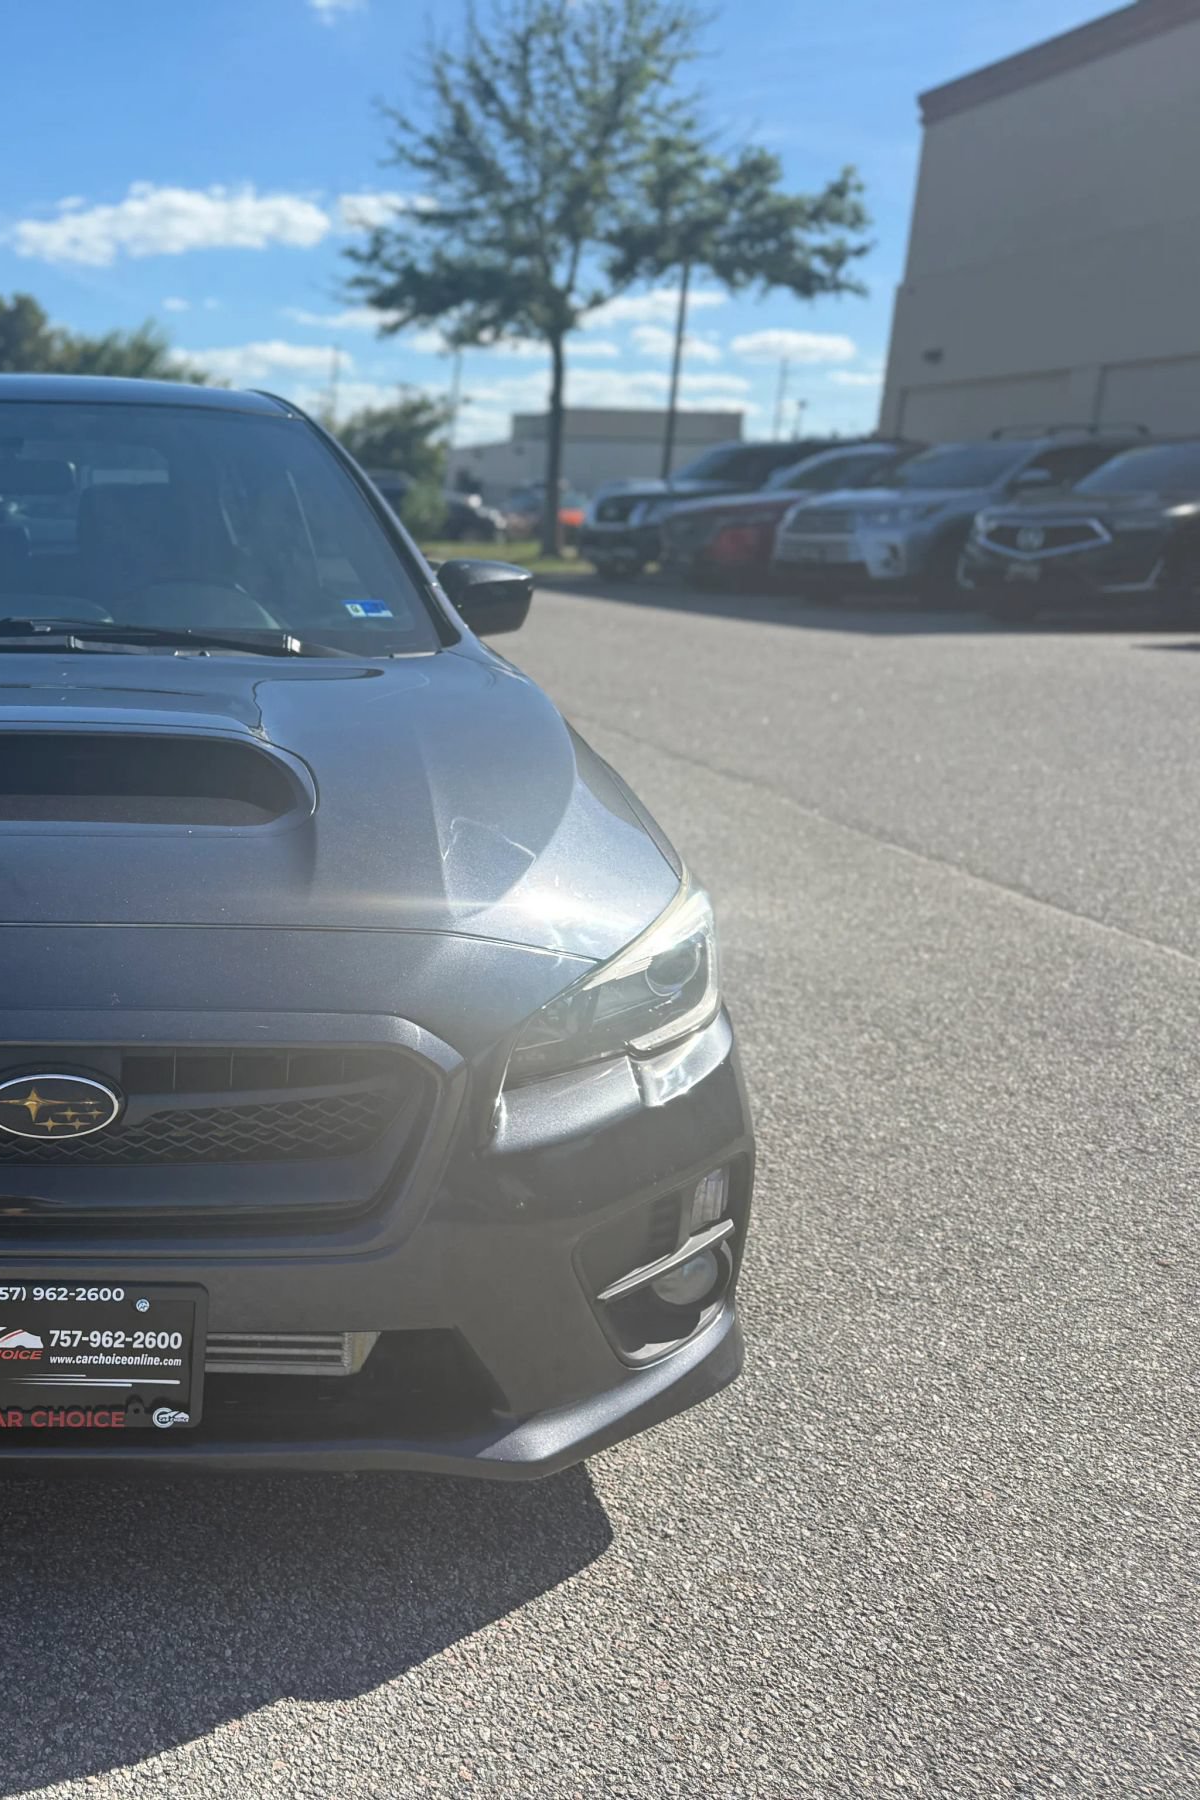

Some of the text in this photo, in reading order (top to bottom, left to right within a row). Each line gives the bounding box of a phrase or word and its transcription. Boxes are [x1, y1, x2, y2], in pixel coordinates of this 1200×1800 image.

[33, 1286, 125, 1302] 962-2600
[49, 1329, 183, 1349] 757-962-2600
[49, 1352, 183, 1367] www.carchoiceonline.com
[30, 1410, 126, 1428] CHOICE
